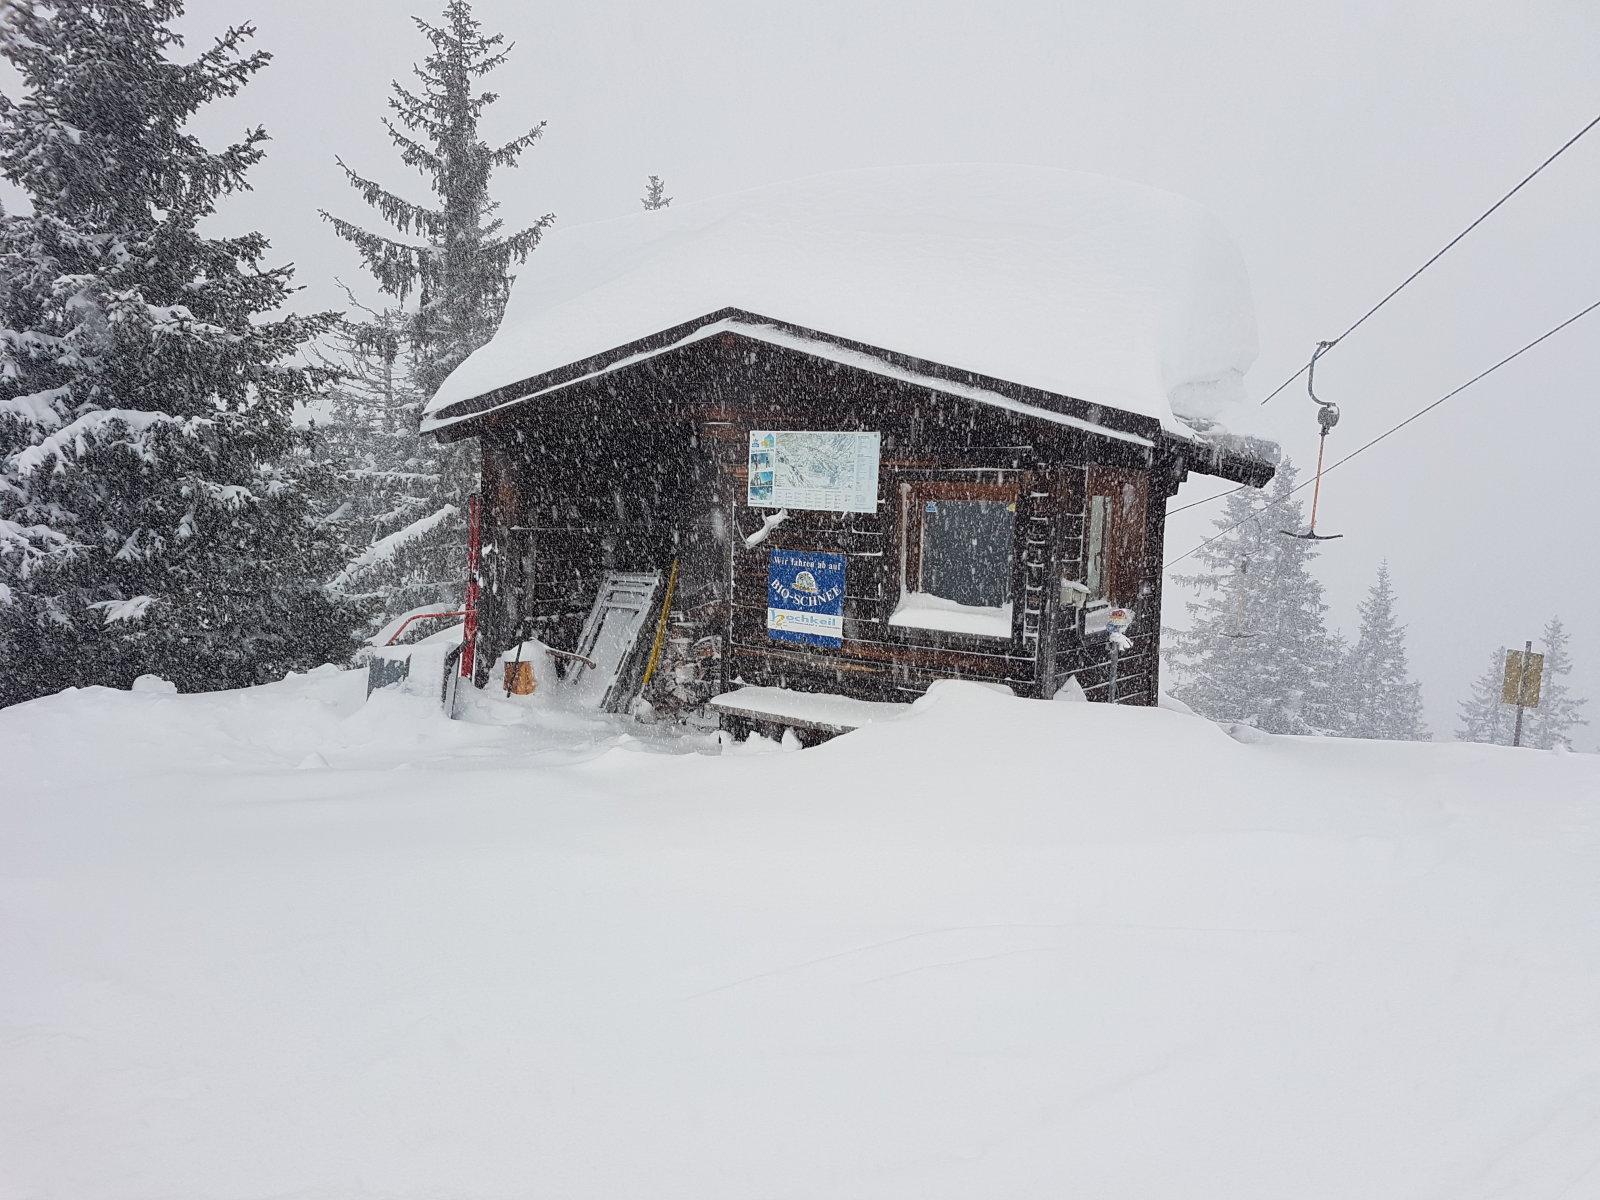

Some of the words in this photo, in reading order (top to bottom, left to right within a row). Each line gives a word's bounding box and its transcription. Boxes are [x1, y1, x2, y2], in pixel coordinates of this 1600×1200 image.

[774, 556, 788, 566] Wir
[791, 557, 815, 568] fahren
[817, 560, 826, 569] ab
[828, 562, 842, 571] auf
[771, 579, 842, 607] BIO-SCHNEE
